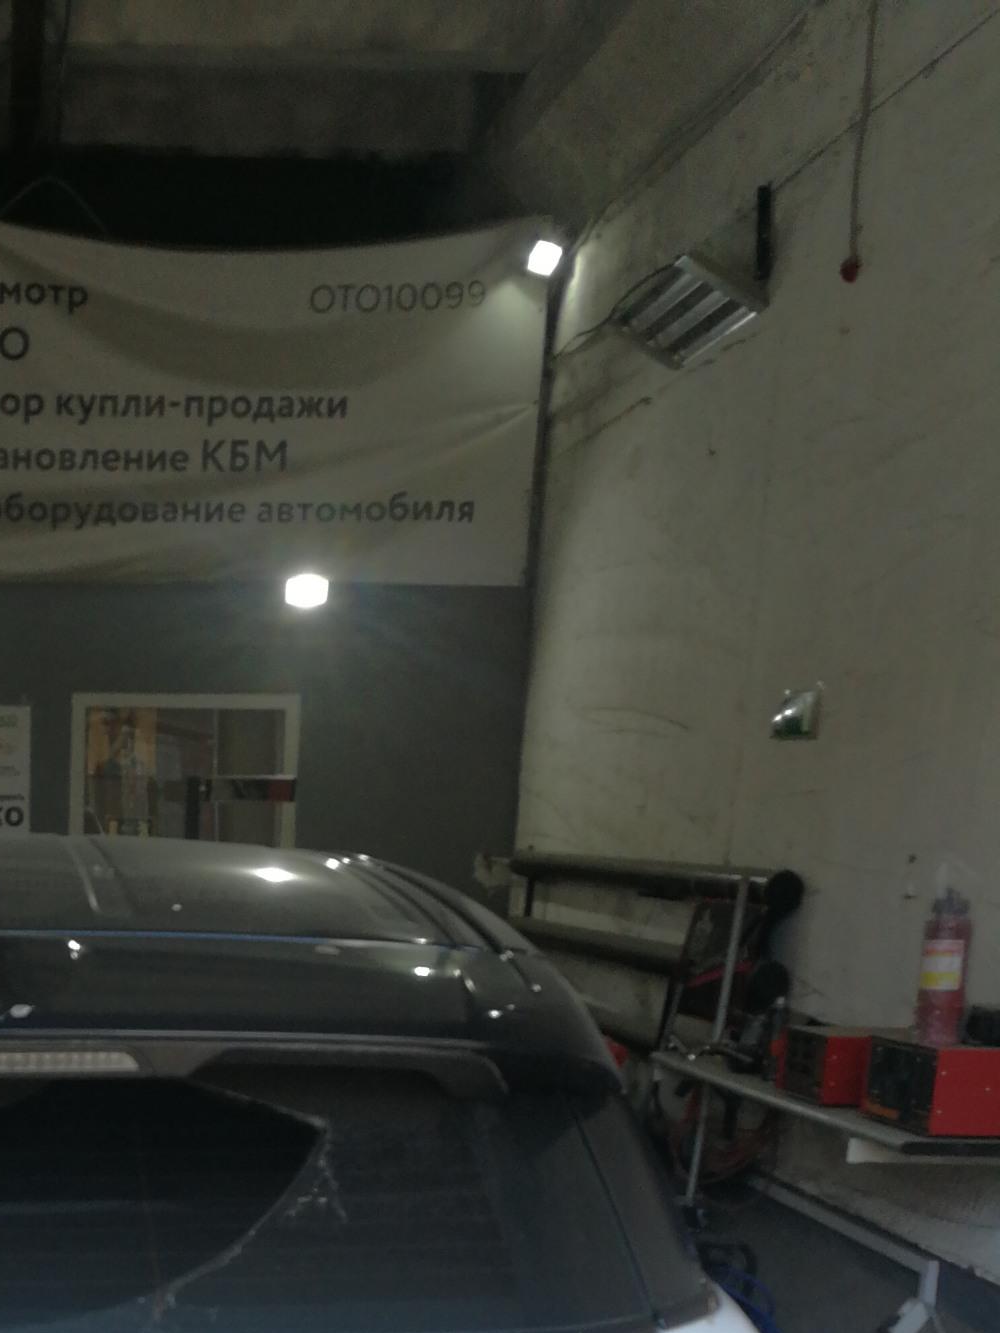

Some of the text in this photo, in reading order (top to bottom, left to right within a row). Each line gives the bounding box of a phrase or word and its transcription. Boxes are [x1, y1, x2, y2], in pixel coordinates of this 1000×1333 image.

[56, 393, 348, 427] купли-продажи
[202, 439, 289, 473] КБМ
[256, 491, 475, 523] автомобиля
